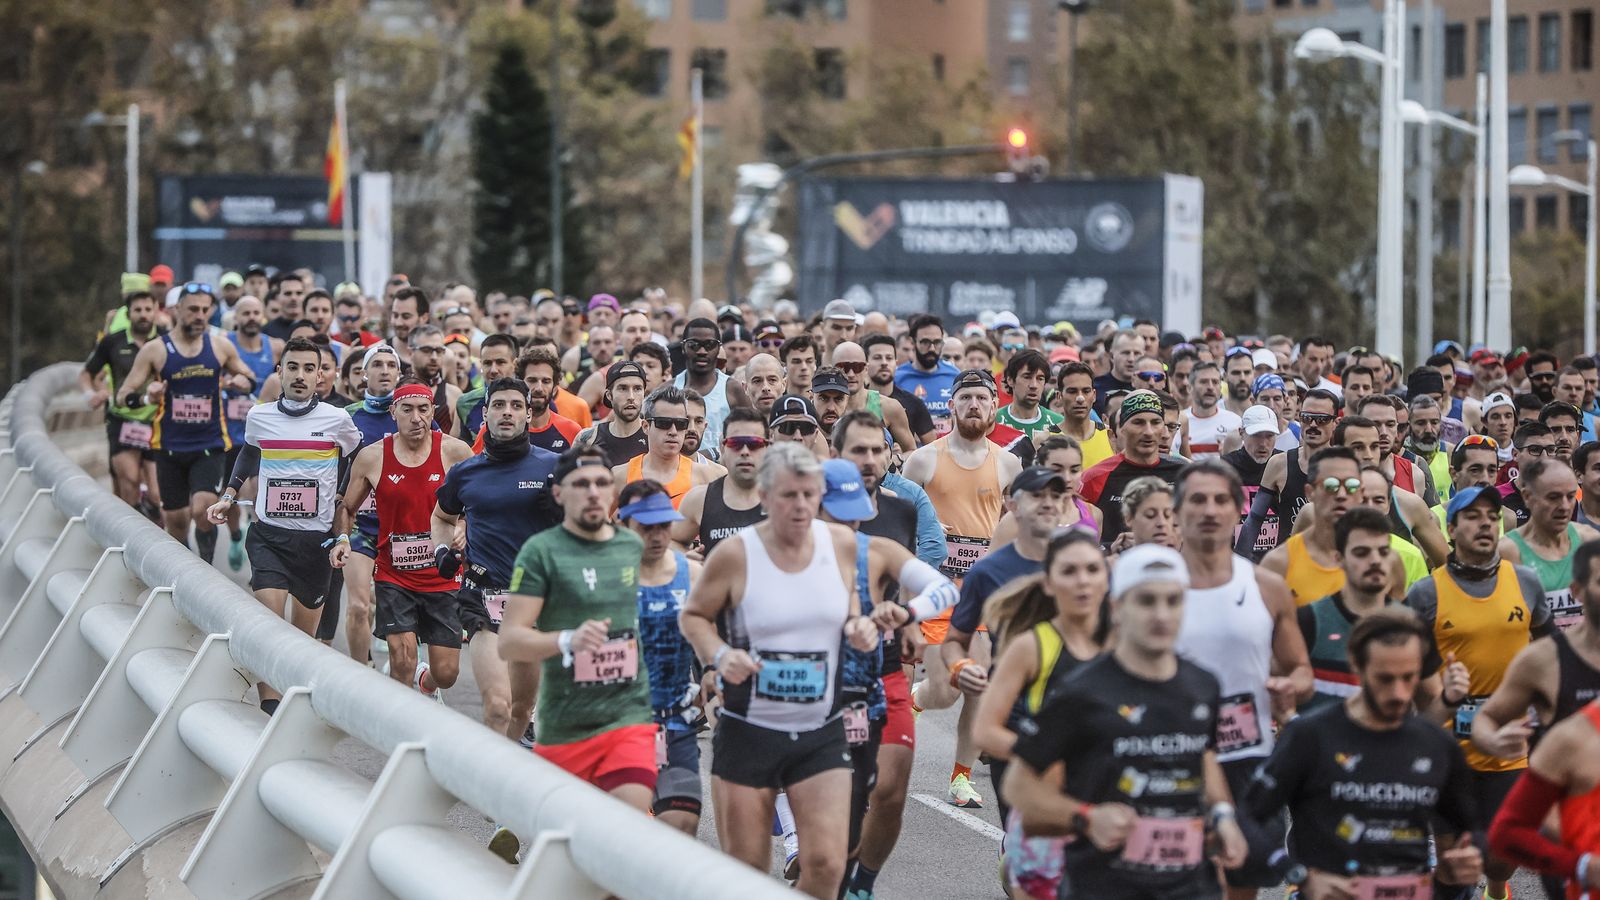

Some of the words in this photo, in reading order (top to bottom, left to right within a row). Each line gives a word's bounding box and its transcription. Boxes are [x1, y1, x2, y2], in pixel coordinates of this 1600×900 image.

[899, 200, 1010, 227] VALENCIA
[988, 228, 1077, 254] ALFONSO
[428, 473, 440, 481] NB
[281, 493, 302, 501] 6737
[276, 502, 306, 511] JHeaL
[407, 545, 428, 555] 6307
[958, 549, 979, 558] 6934
[394, 552, 435, 563] JOSEPMAR
